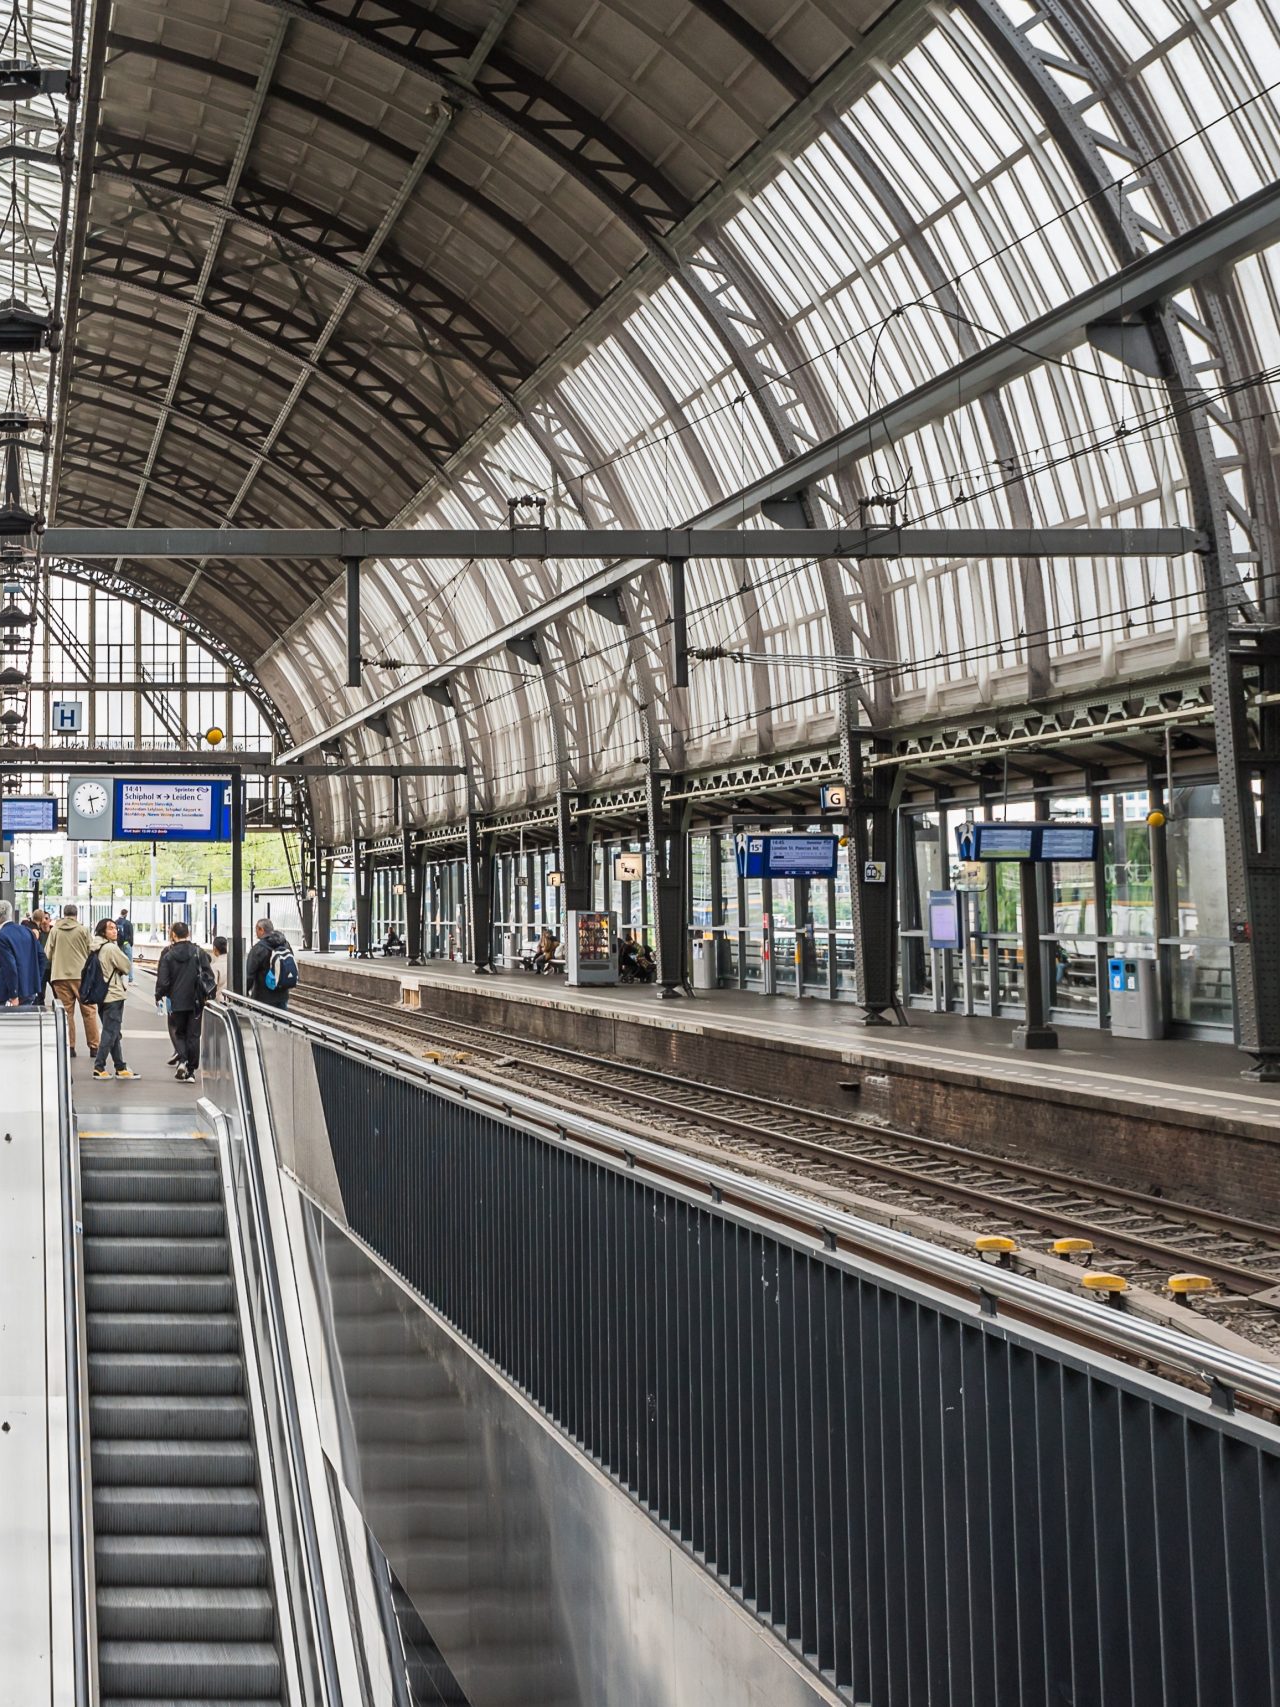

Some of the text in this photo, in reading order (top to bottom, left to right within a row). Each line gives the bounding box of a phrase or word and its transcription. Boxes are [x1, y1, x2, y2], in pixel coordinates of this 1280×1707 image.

[60, 709, 75, 727] H
[124, 793, 154, 801] Schiphol
[172, 793, 195, 801] Leiden
[226, 793, 231, 803] 1
[830, 793, 841, 805] G
[33, 869, 41, 878] G
